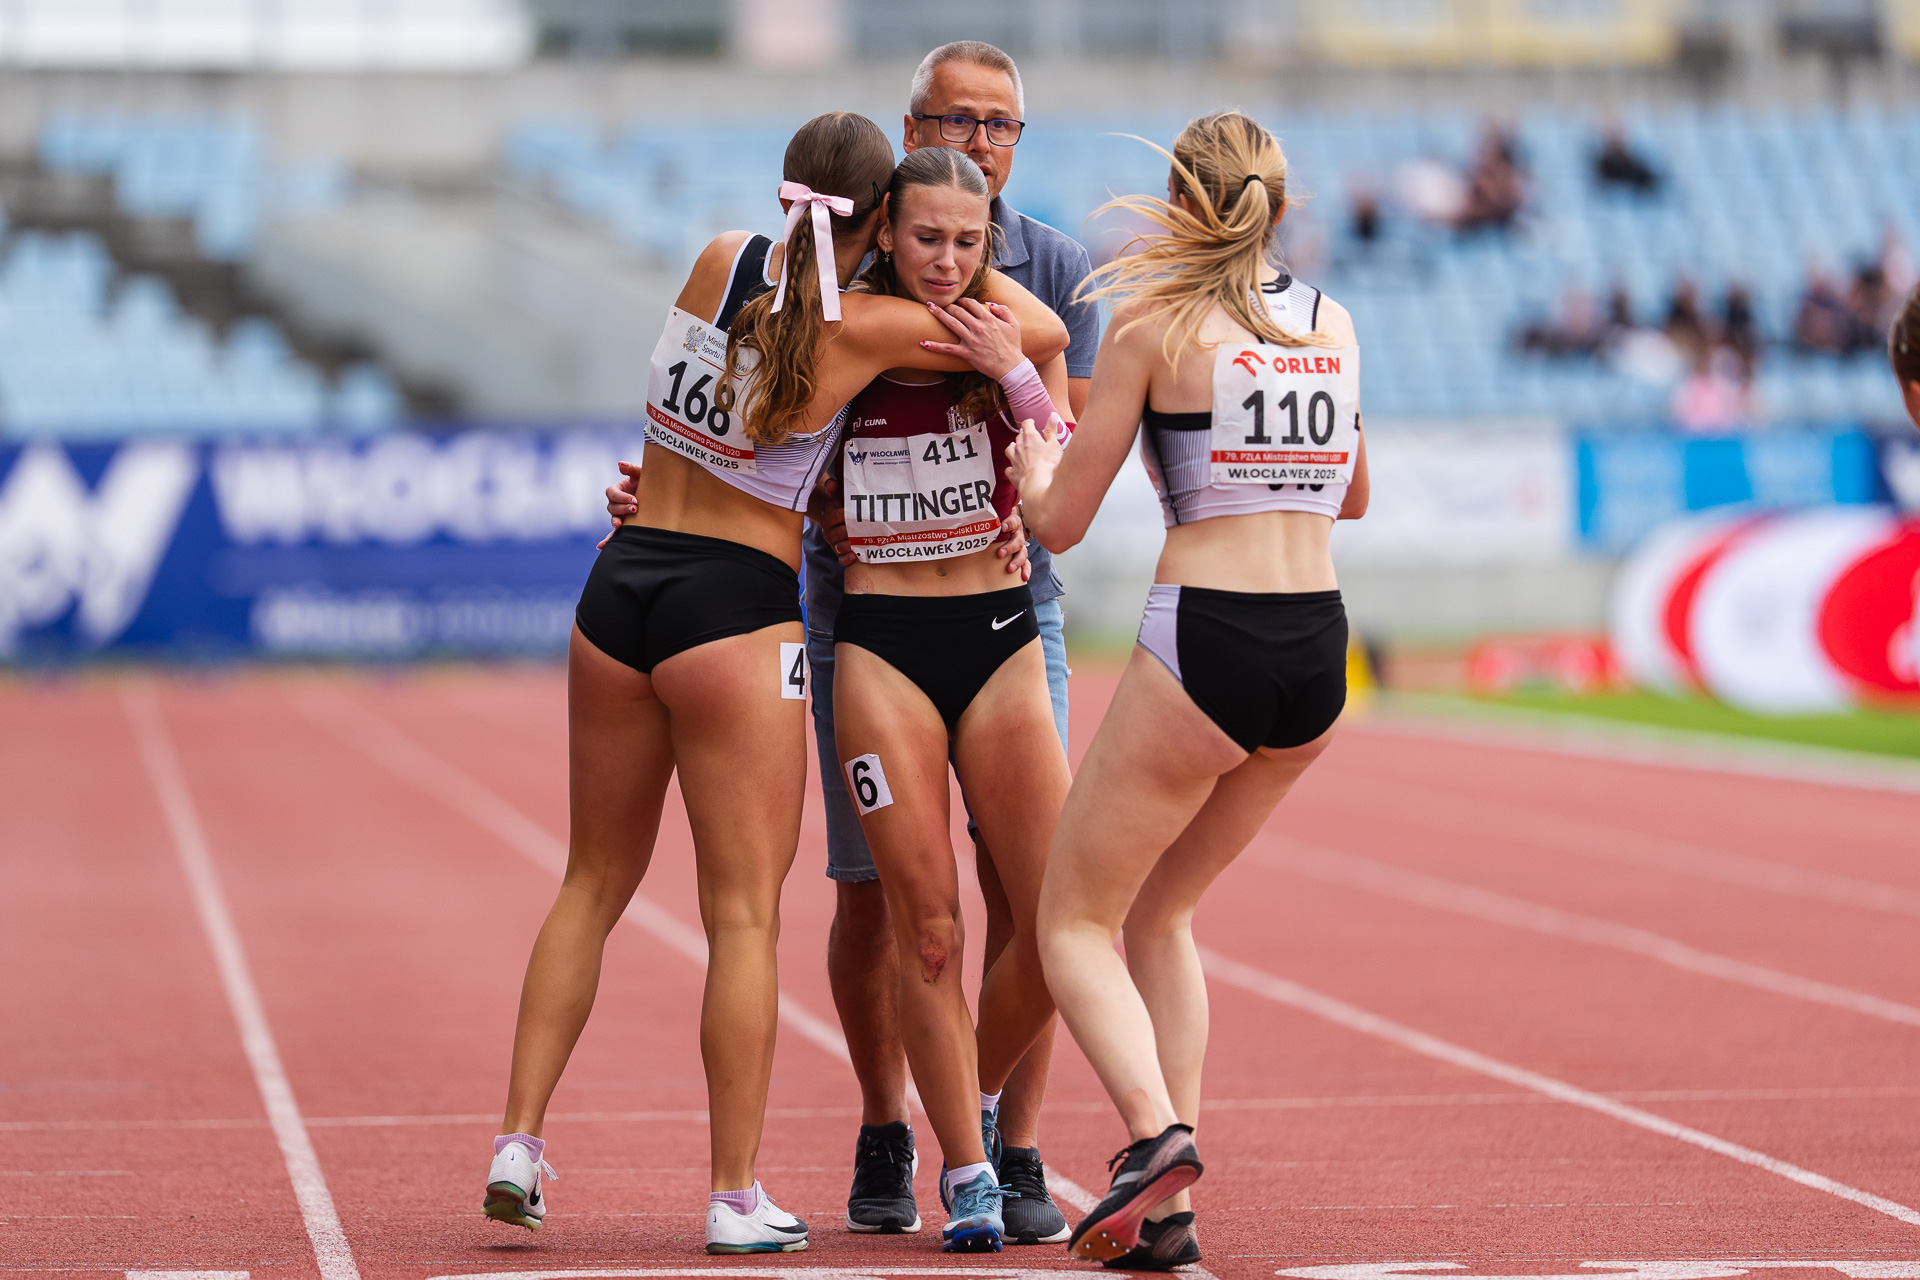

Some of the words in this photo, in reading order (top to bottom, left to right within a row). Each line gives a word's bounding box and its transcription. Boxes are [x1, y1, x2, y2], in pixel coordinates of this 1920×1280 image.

[701, 344, 721, 359] Sportu
[1272, 356, 1341, 375] ORLEN
[661, 360, 736, 437] 168
[864, 418, 888, 427] CUNA
[1241, 389, 1335, 446] 110
[650, 422, 707, 462] WŁOCŁAWEK
[709, 454, 739, 470] 2025
[657, 412, 670, 426] PZLA
[669, 421, 706, 444] Mistrzostwa
[705, 438, 725, 453] Polski
[725, 447, 741, 457] U20
[922, 434, 979, 466] 411
[1225, 452, 1239, 461] 79.
[1240, 452, 1261, 461] PZLA
[1262, 452, 1309, 462] Mistrzostwa
[1309, 454, 1329, 462] Polski
[1228, 468, 1312, 479] WŁOCŁAWEK
[1313, 469, 1336, 480] 2025
[850, 480, 991, 523] TITTINGER
[973, 522, 991, 532] U20
[866, 542, 954, 559] WŁOCŁAWEK
[956, 536, 989, 552] 2025
[788, 647, 805, 695] 4
[852, 760, 878, 808] 6
